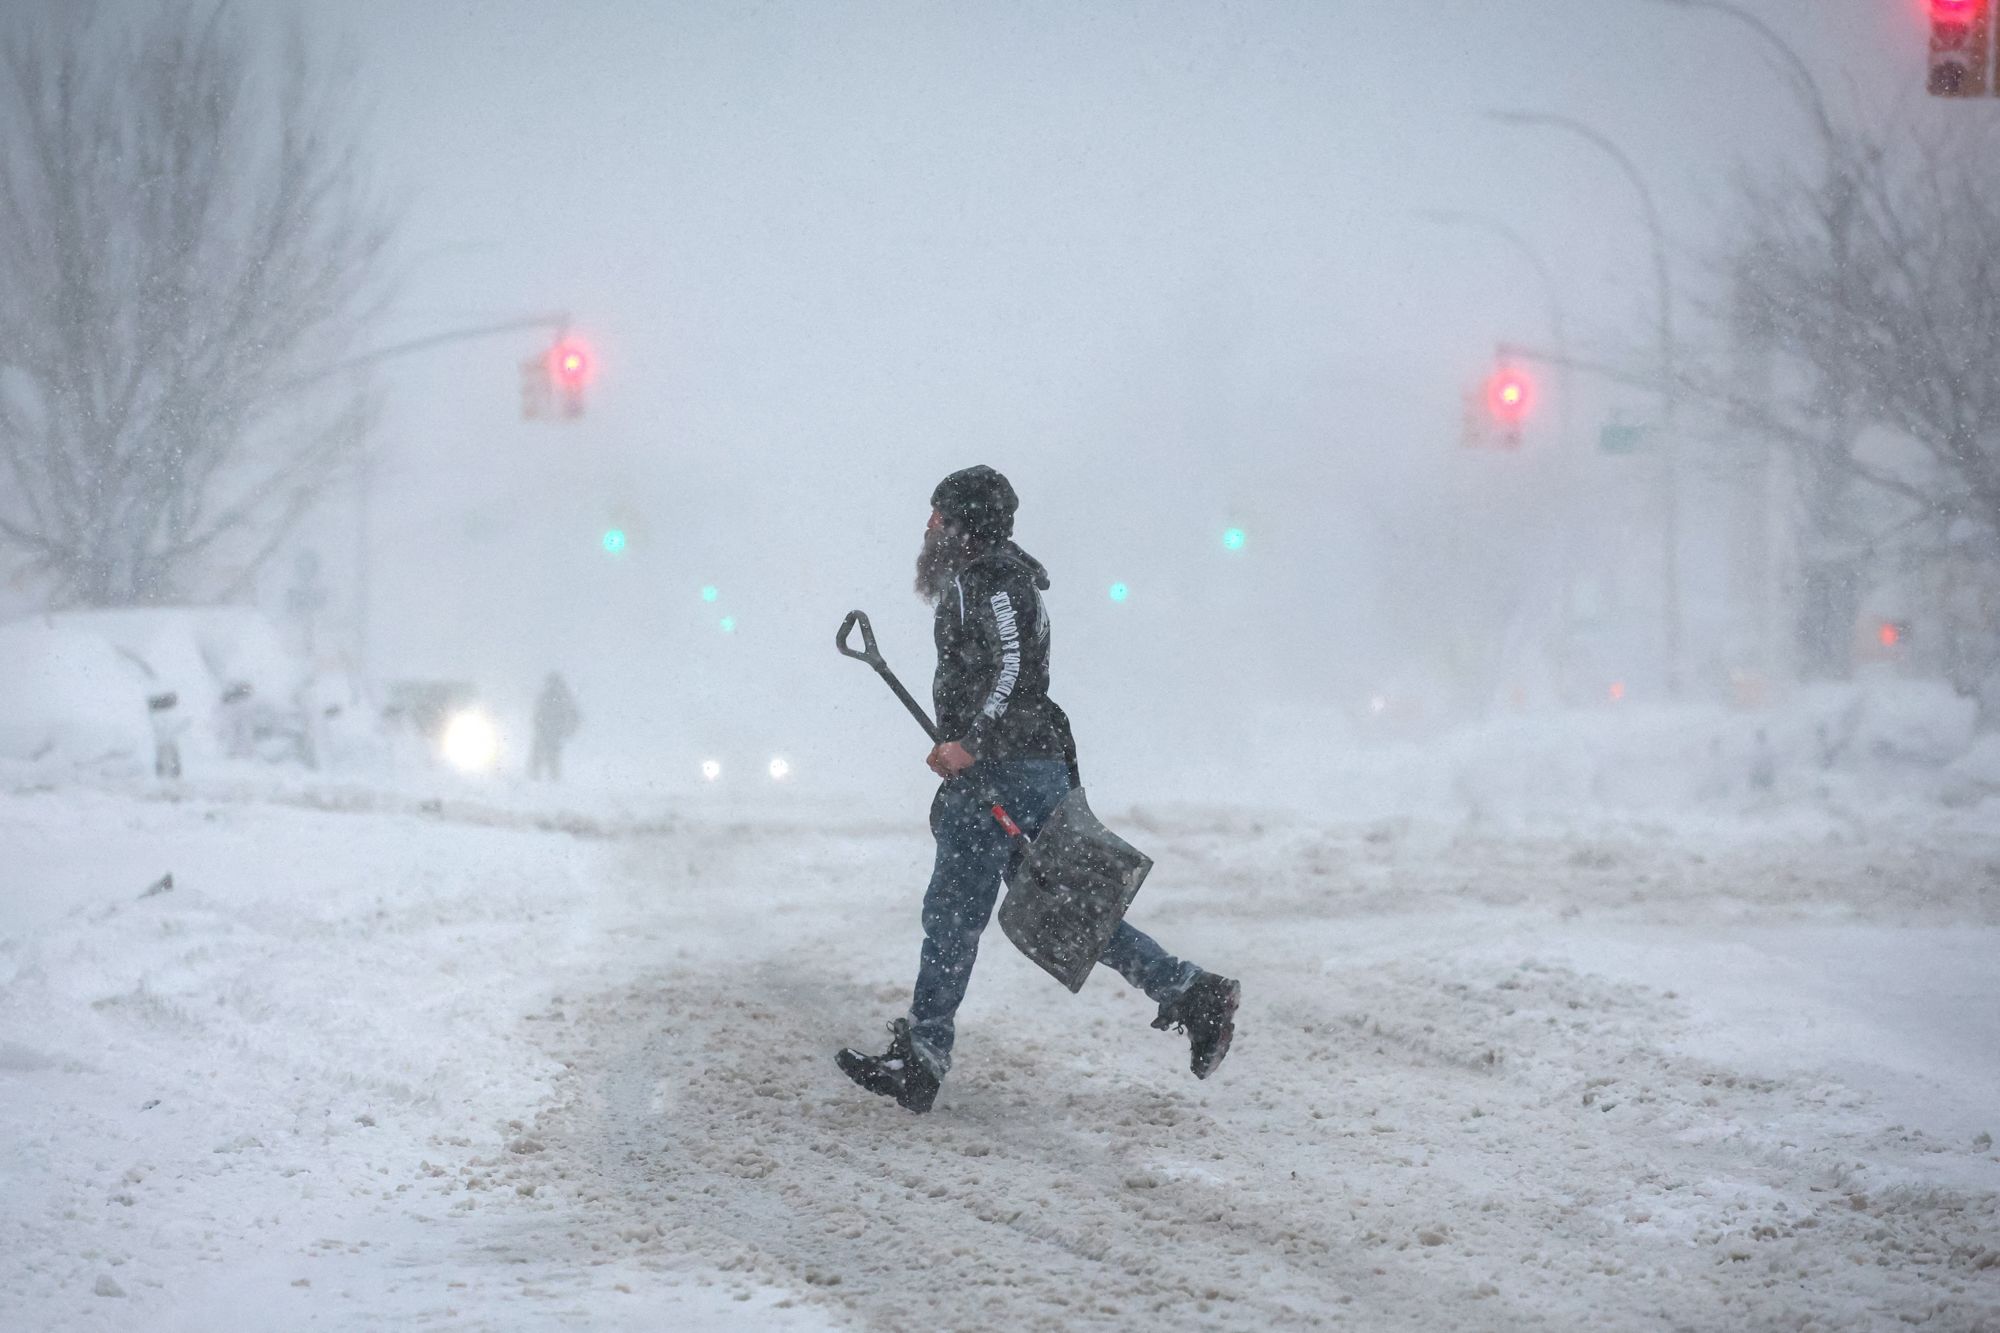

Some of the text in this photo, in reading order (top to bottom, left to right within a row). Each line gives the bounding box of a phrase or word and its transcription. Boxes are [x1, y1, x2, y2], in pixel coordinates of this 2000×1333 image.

[990, 591, 1021, 696] DESTROY & CONQUER
